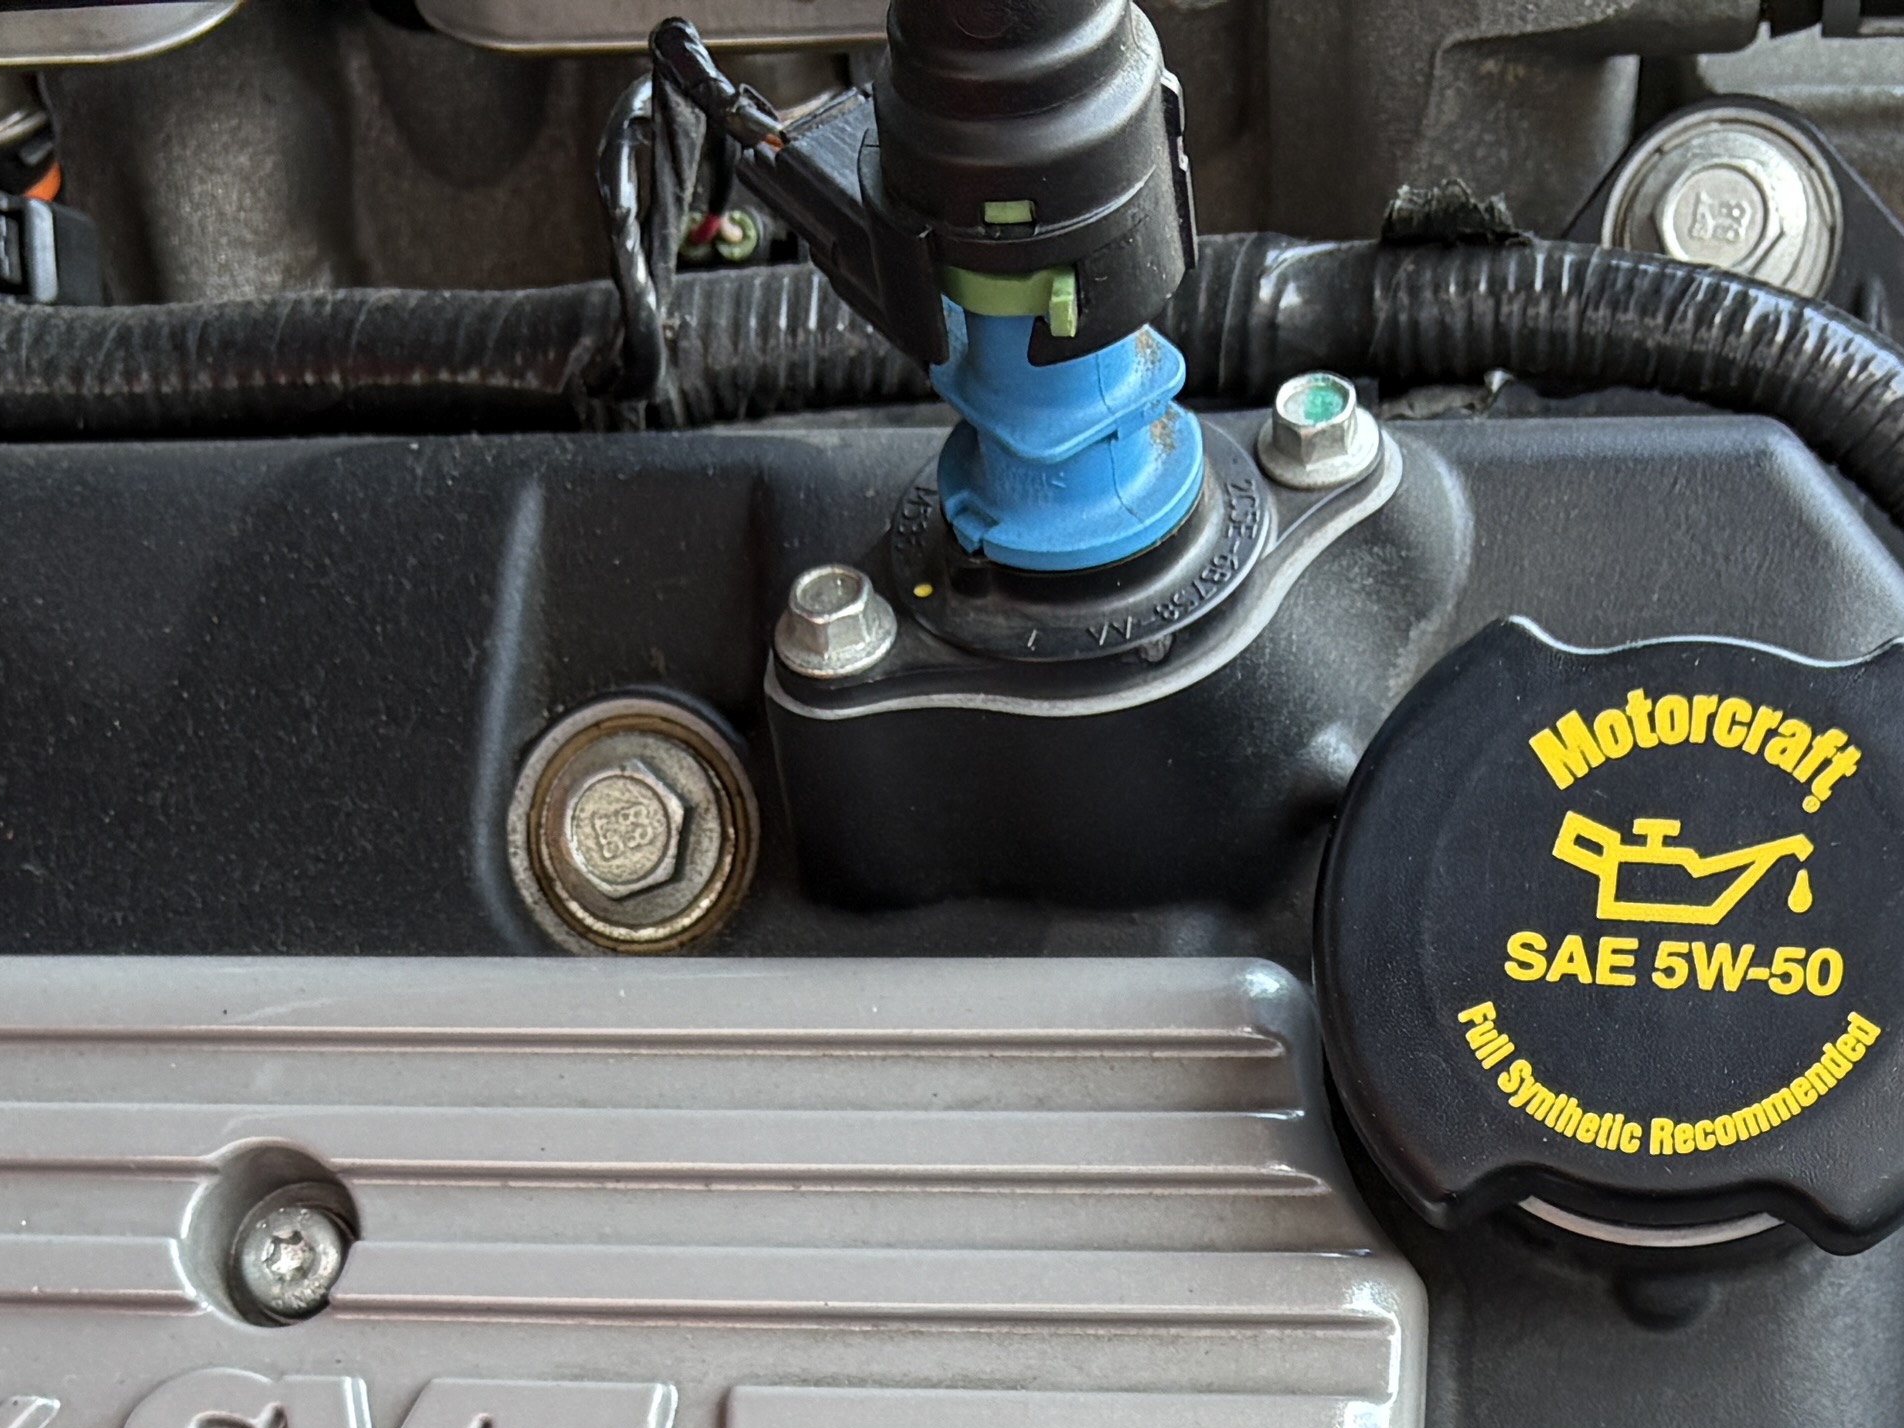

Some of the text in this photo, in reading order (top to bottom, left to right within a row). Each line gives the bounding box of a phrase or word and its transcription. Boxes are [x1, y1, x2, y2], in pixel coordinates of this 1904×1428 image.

[1528, 687, 1862, 802] Motorcraft
[1504, 931, 1844, 997] SAE 5W-50
[1457, 1000, 1882, 1156] Full Synthetic Recommended
